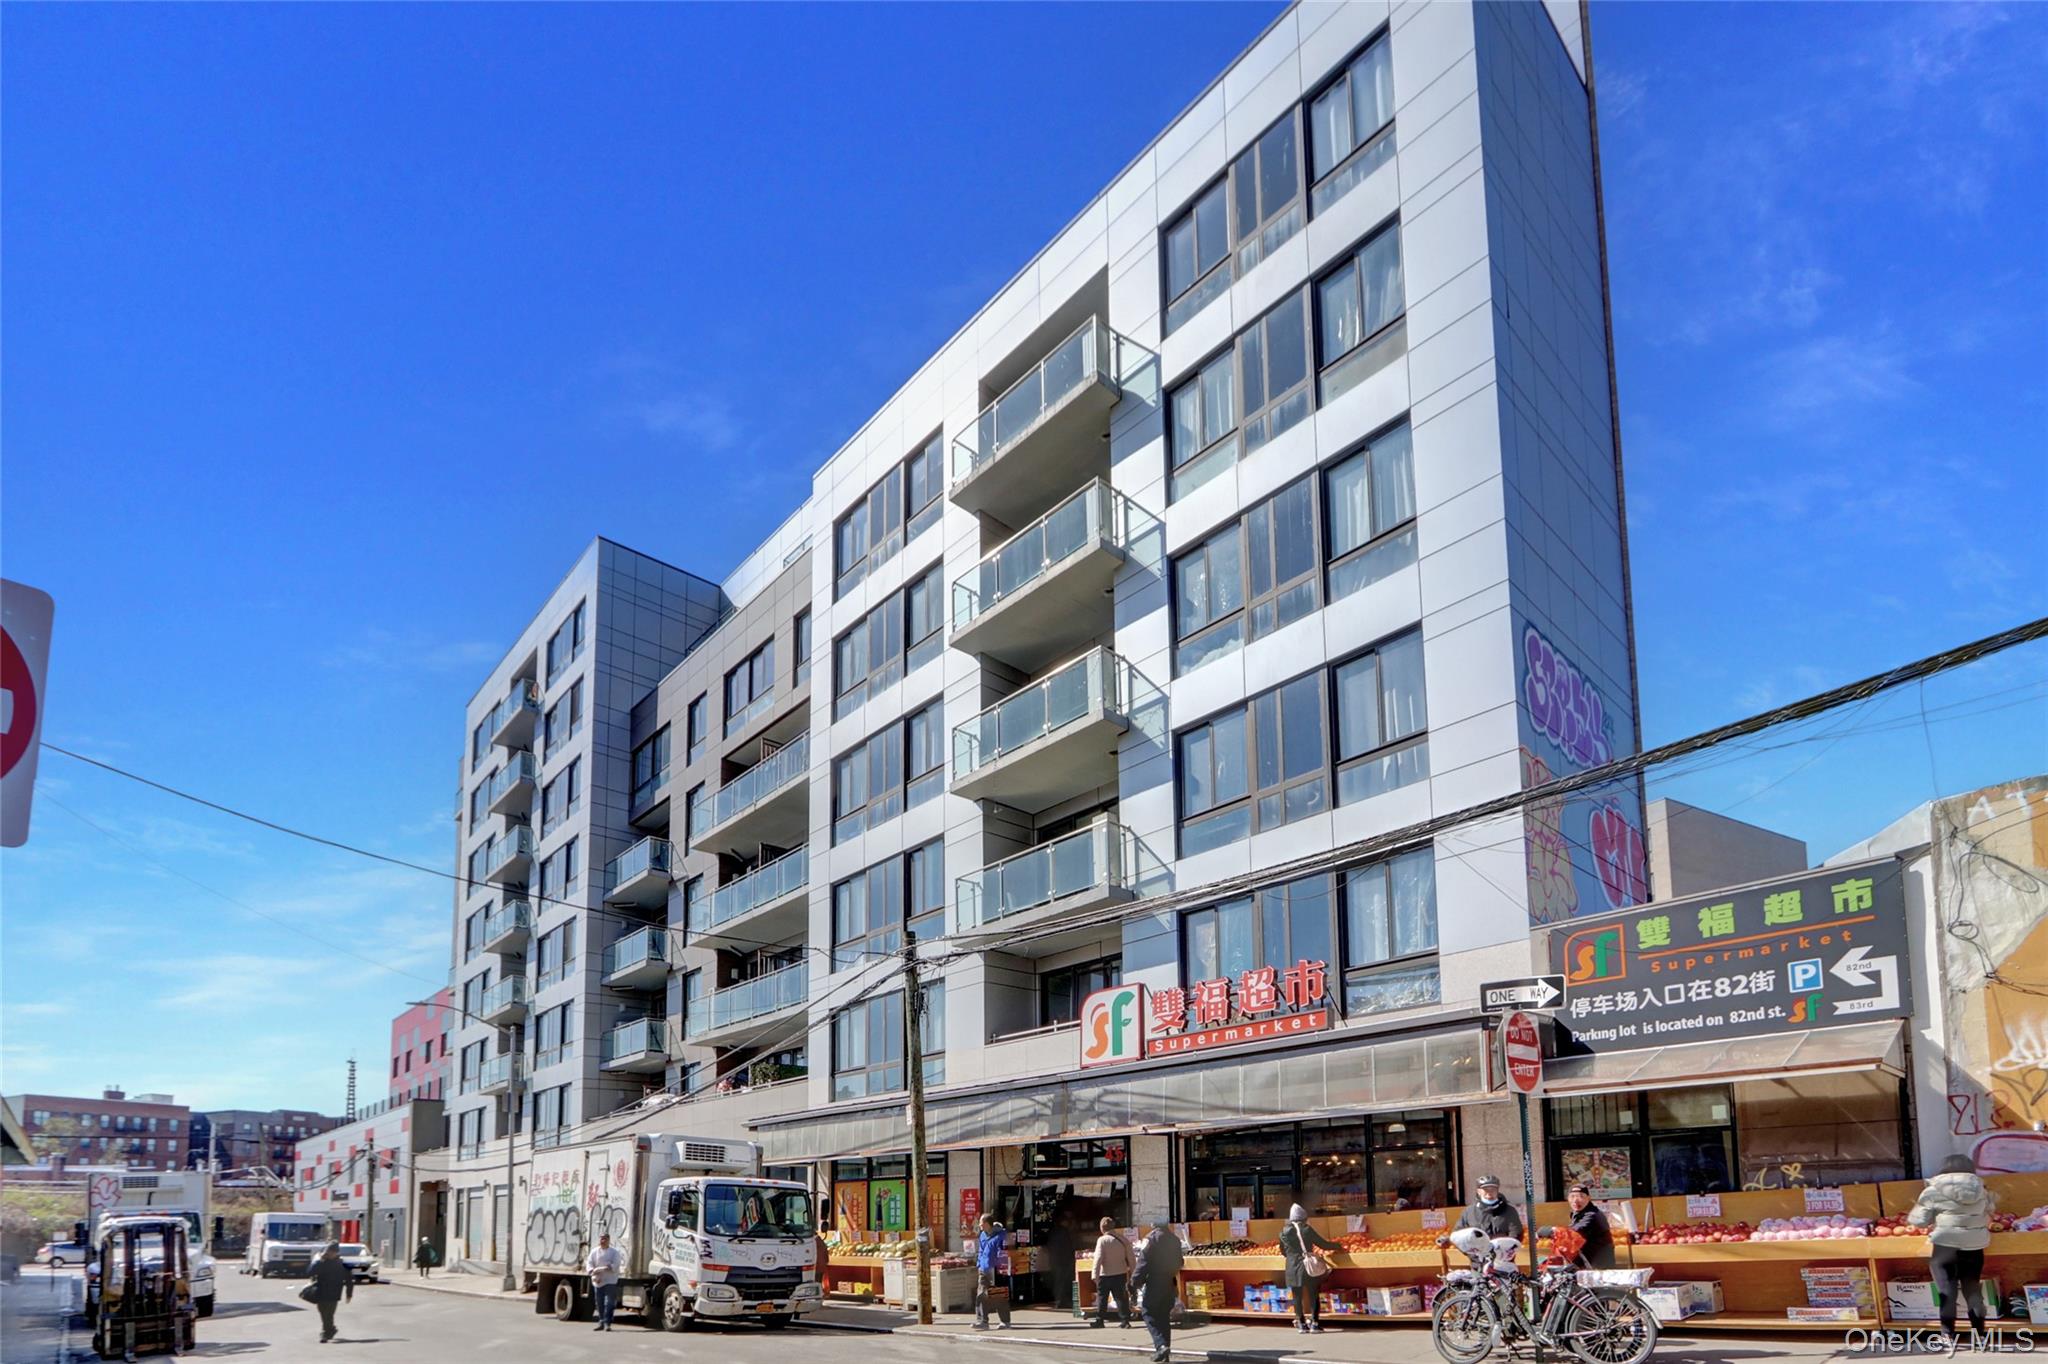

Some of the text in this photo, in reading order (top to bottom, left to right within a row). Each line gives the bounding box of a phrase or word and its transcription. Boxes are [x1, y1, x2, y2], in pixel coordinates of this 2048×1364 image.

[1636, 878, 1874, 949] 雙福超市
[1652, 930, 1853, 972] Supermarket
[1846, 961, 1873, 972] 82nd
[1150, 959, 1328, 1034] 雙福超市
[1489, 986, 1549, 1004] ONE WAY
[1570, 970, 1776, 1020] 停车场入口在82街
[1154, 1013, 1318, 1052] Supermarket
[1510, 1025, 1533, 1042] DO NOT
[1571, 1005, 1786, 1043] Parking lot is located on 82nd st.
[1514, 1062, 1535, 1077] ENTER
